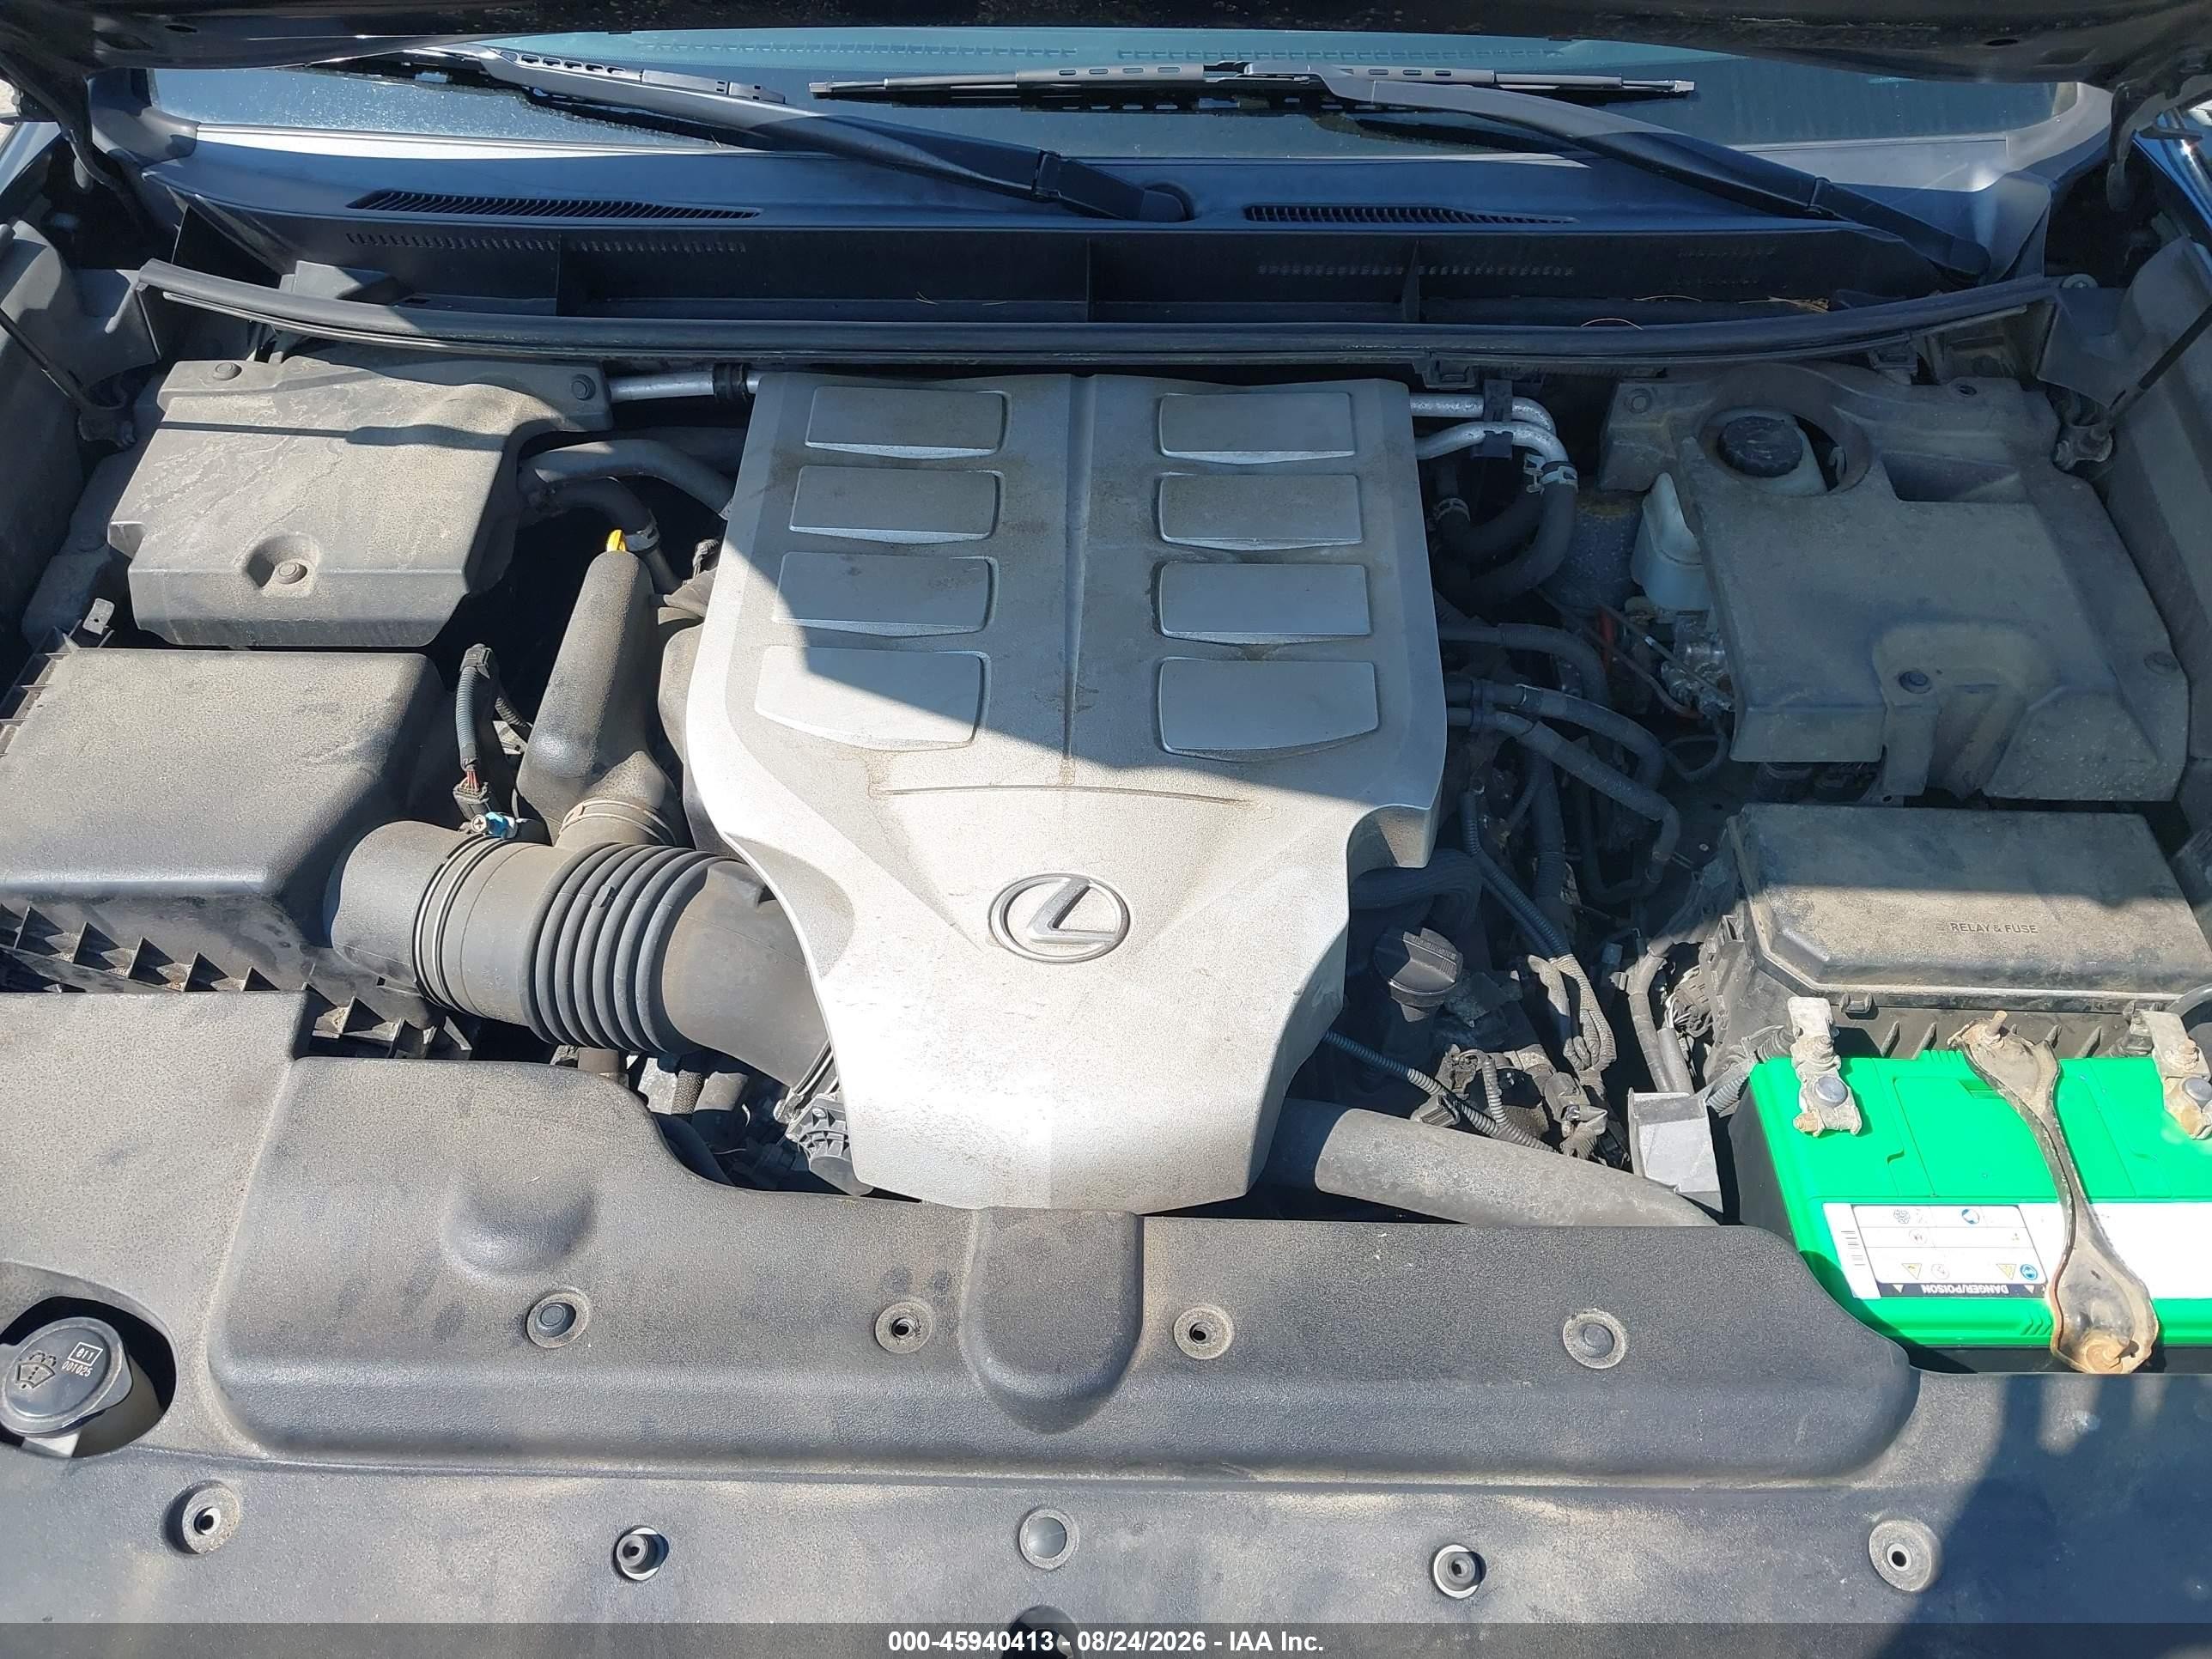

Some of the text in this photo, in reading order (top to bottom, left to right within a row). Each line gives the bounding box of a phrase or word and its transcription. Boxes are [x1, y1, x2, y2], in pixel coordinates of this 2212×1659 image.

[1950, 922, 2039, 934] RELAY & FUSE
[1920, 1284, 2009, 1294] DANGER/POISON
[62, 1361, 93, 1376] 001025
